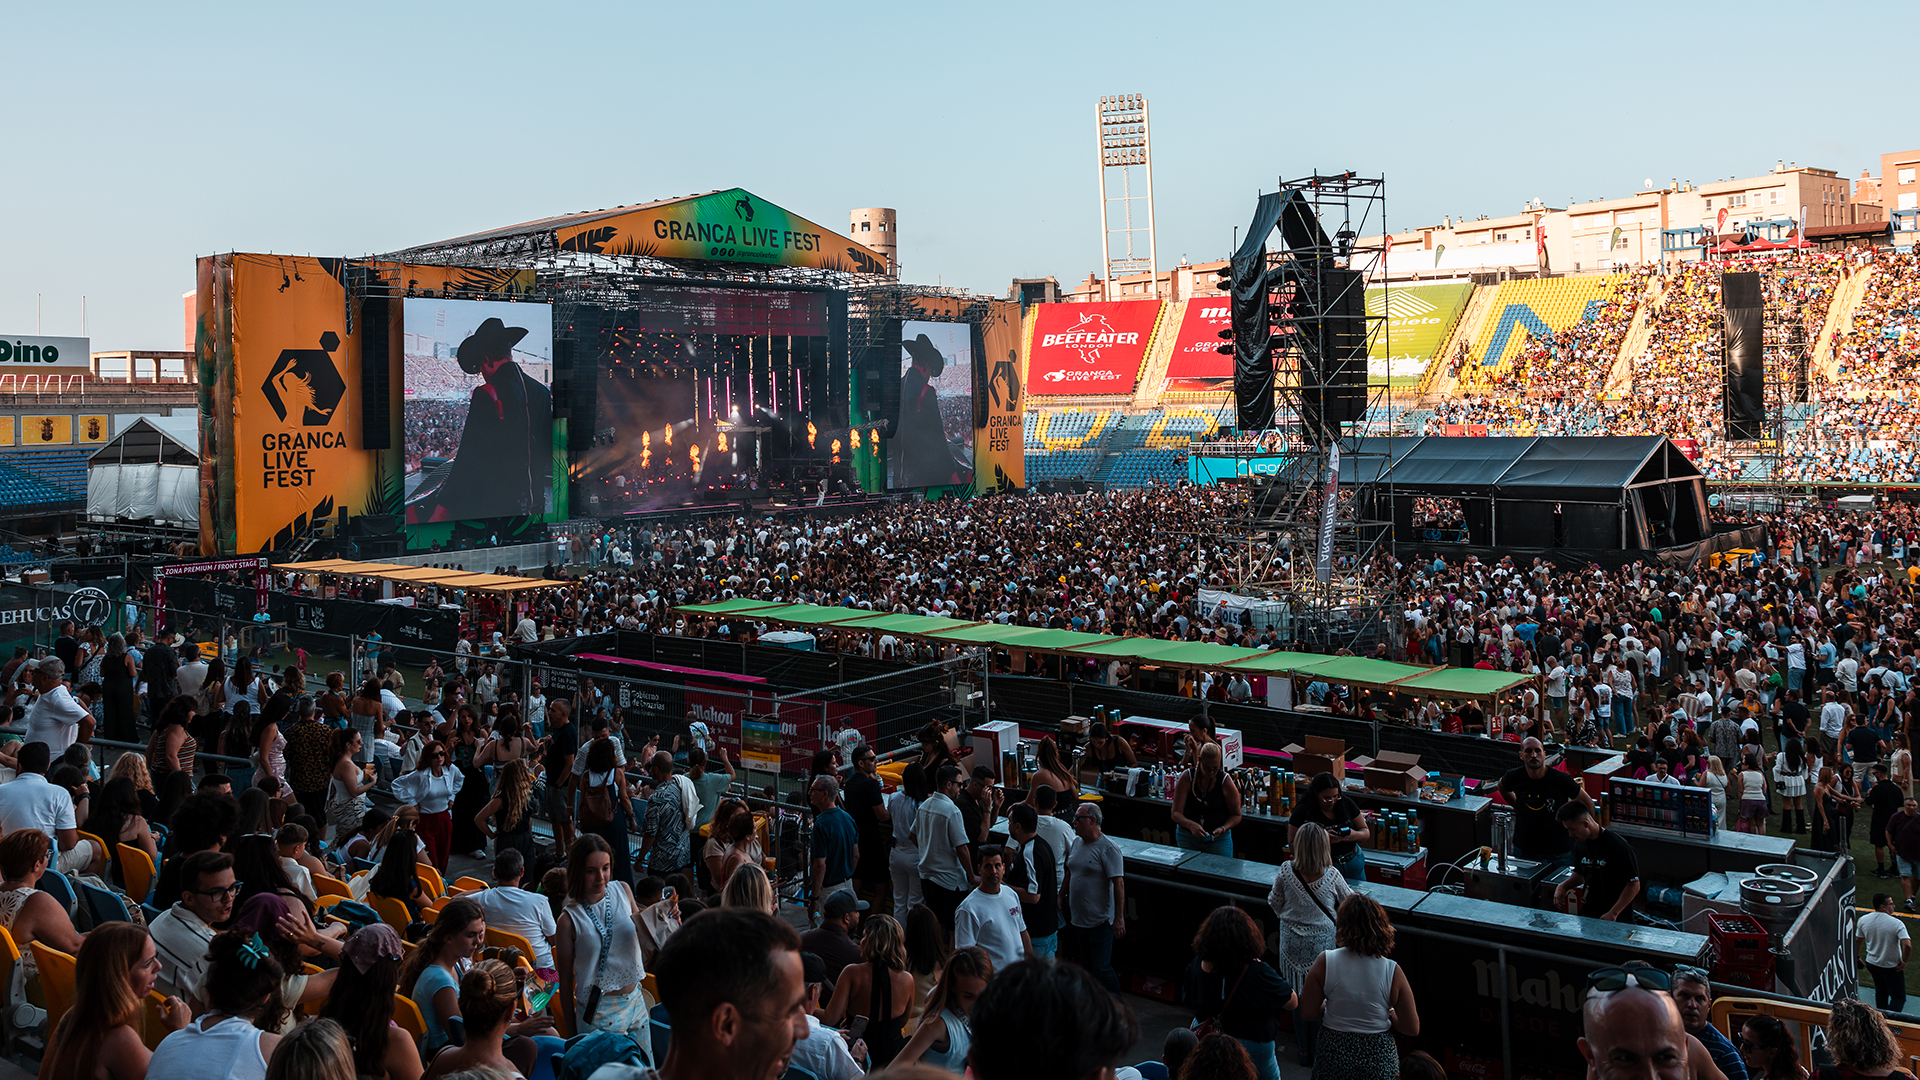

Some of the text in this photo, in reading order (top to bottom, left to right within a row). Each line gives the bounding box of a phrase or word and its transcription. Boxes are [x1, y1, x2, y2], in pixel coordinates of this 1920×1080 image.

[654, 219, 821, 252] GRANCA LIVE FEST
[1042, 332, 1139, 347] BEEFEATER
[990, 415, 1022, 427] GRANCA
[262, 432, 347, 450] GRANCA
[990, 428, 1008, 439] LIVE
[990, 440, 1010, 452] FEST
[263, 451, 308, 469] LIVE
[263, 469, 316, 488] FEST
[165, 567, 183, 576] ZONA
[183, 563, 213, 574] PREMIUM
[218, 561, 237, 571] FRONT
[237, 559, 258, 569] STAGE
[0, 605, 72, 625] EHUCAS
[80, 600, 97, 622] 7
[691, 703, 734, 726] Mahou
[1471, 957, 1588, 1014] Mah
[1479, 1006, 1560, 1038] DSDE
